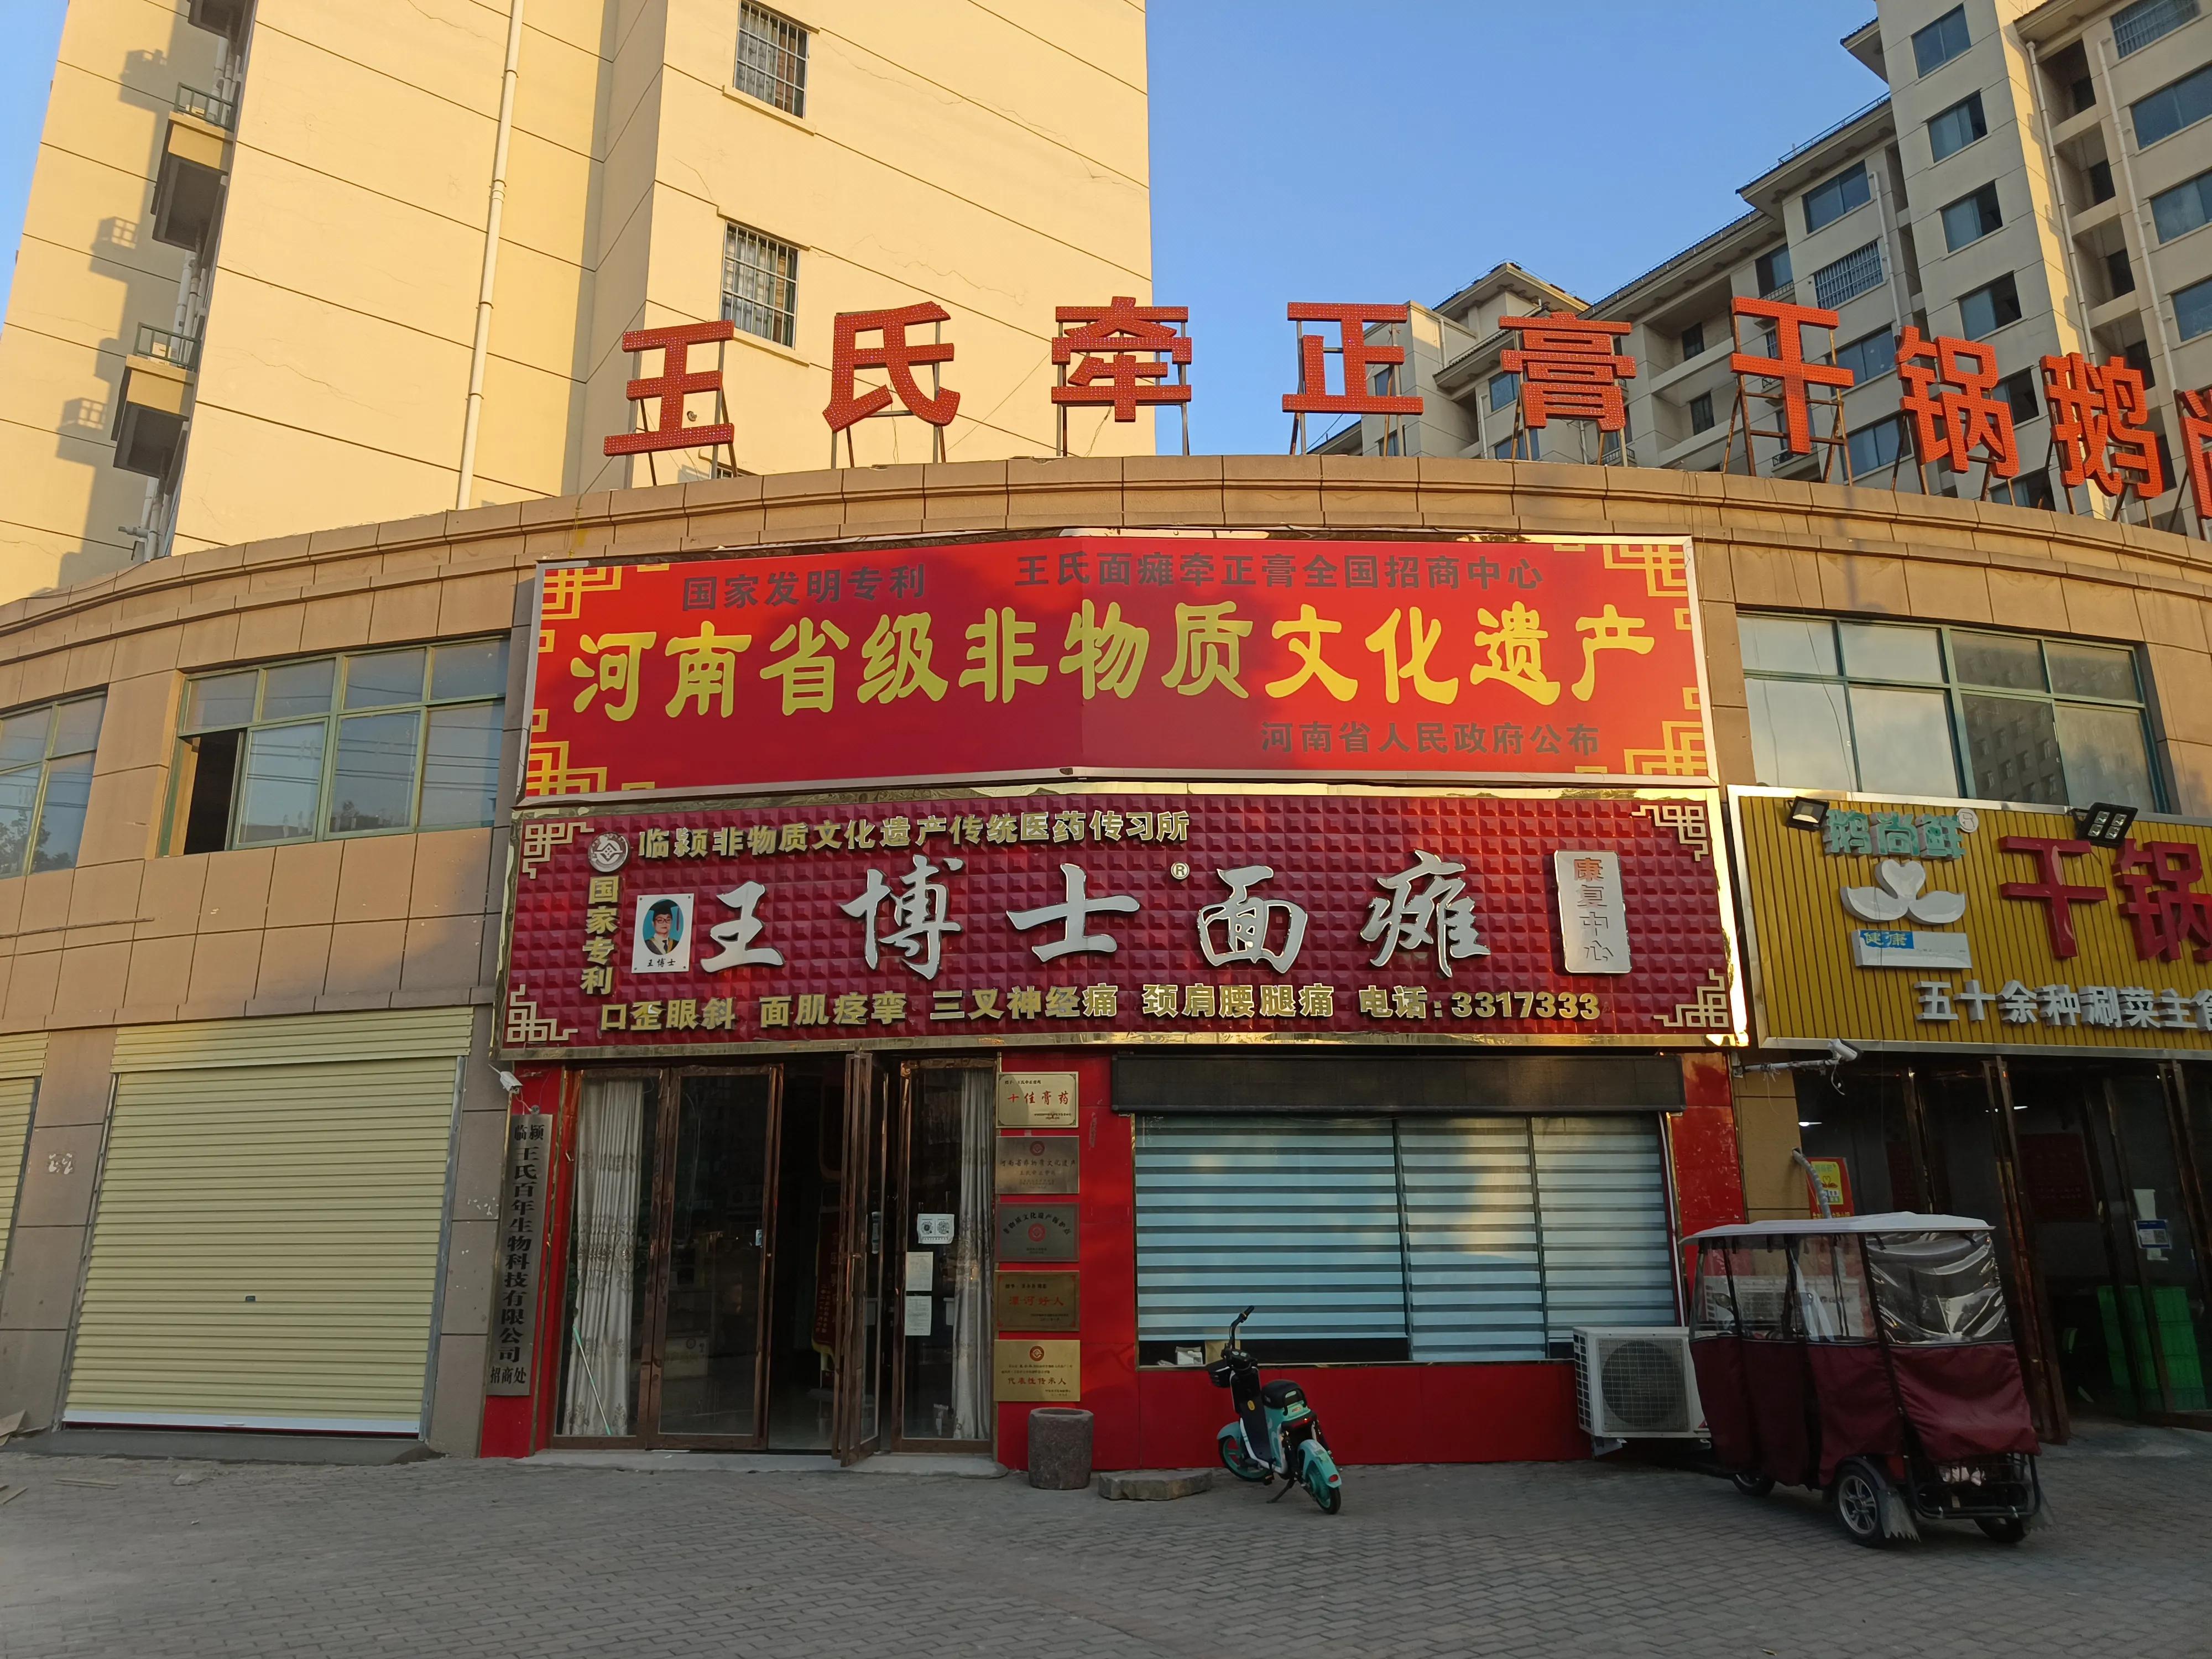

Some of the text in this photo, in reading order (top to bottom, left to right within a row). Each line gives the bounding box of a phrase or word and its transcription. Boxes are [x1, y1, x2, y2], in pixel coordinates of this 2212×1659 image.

[603, 296, 1637, 457] 王氏牵正膏
[681, 562, 925, 612] 国家发明专利
[1014, 550, 1544, 591] 王氏面瘫牵正膏全国招商中心
[570, 599, 1655, 722] 河南省级非物质文化遗产
[1261, 720, 1600, 757] 河南省人民政府公布
[639, 810, 1190, 859] 临颍非物质文化遗产传统医药传习所
[1573, 857, 1614, 963] 康复中心
[1999, 835, 2212, 962] 干锅
[580, 875, 620, 995] 国家专利
[1863, 931, 1907, 947] 健康
[647, 957, 676, 968] 王博士
[601, 996, 737, 1032] 口歪眼斜
[759, 991, 907, 1029] 面肌痉挛
[930, 982, 1118, 1021] 三叉神经痛
[1142, 982, 1334, 1018] 颈肩腰腿痛
[1007, 1090, 1069, 1105] 十佳膏药
[498, 1146, 540, 1364] 王氏百年生物科技有限公司
[490, 1366, 526, 1385] 招商处
